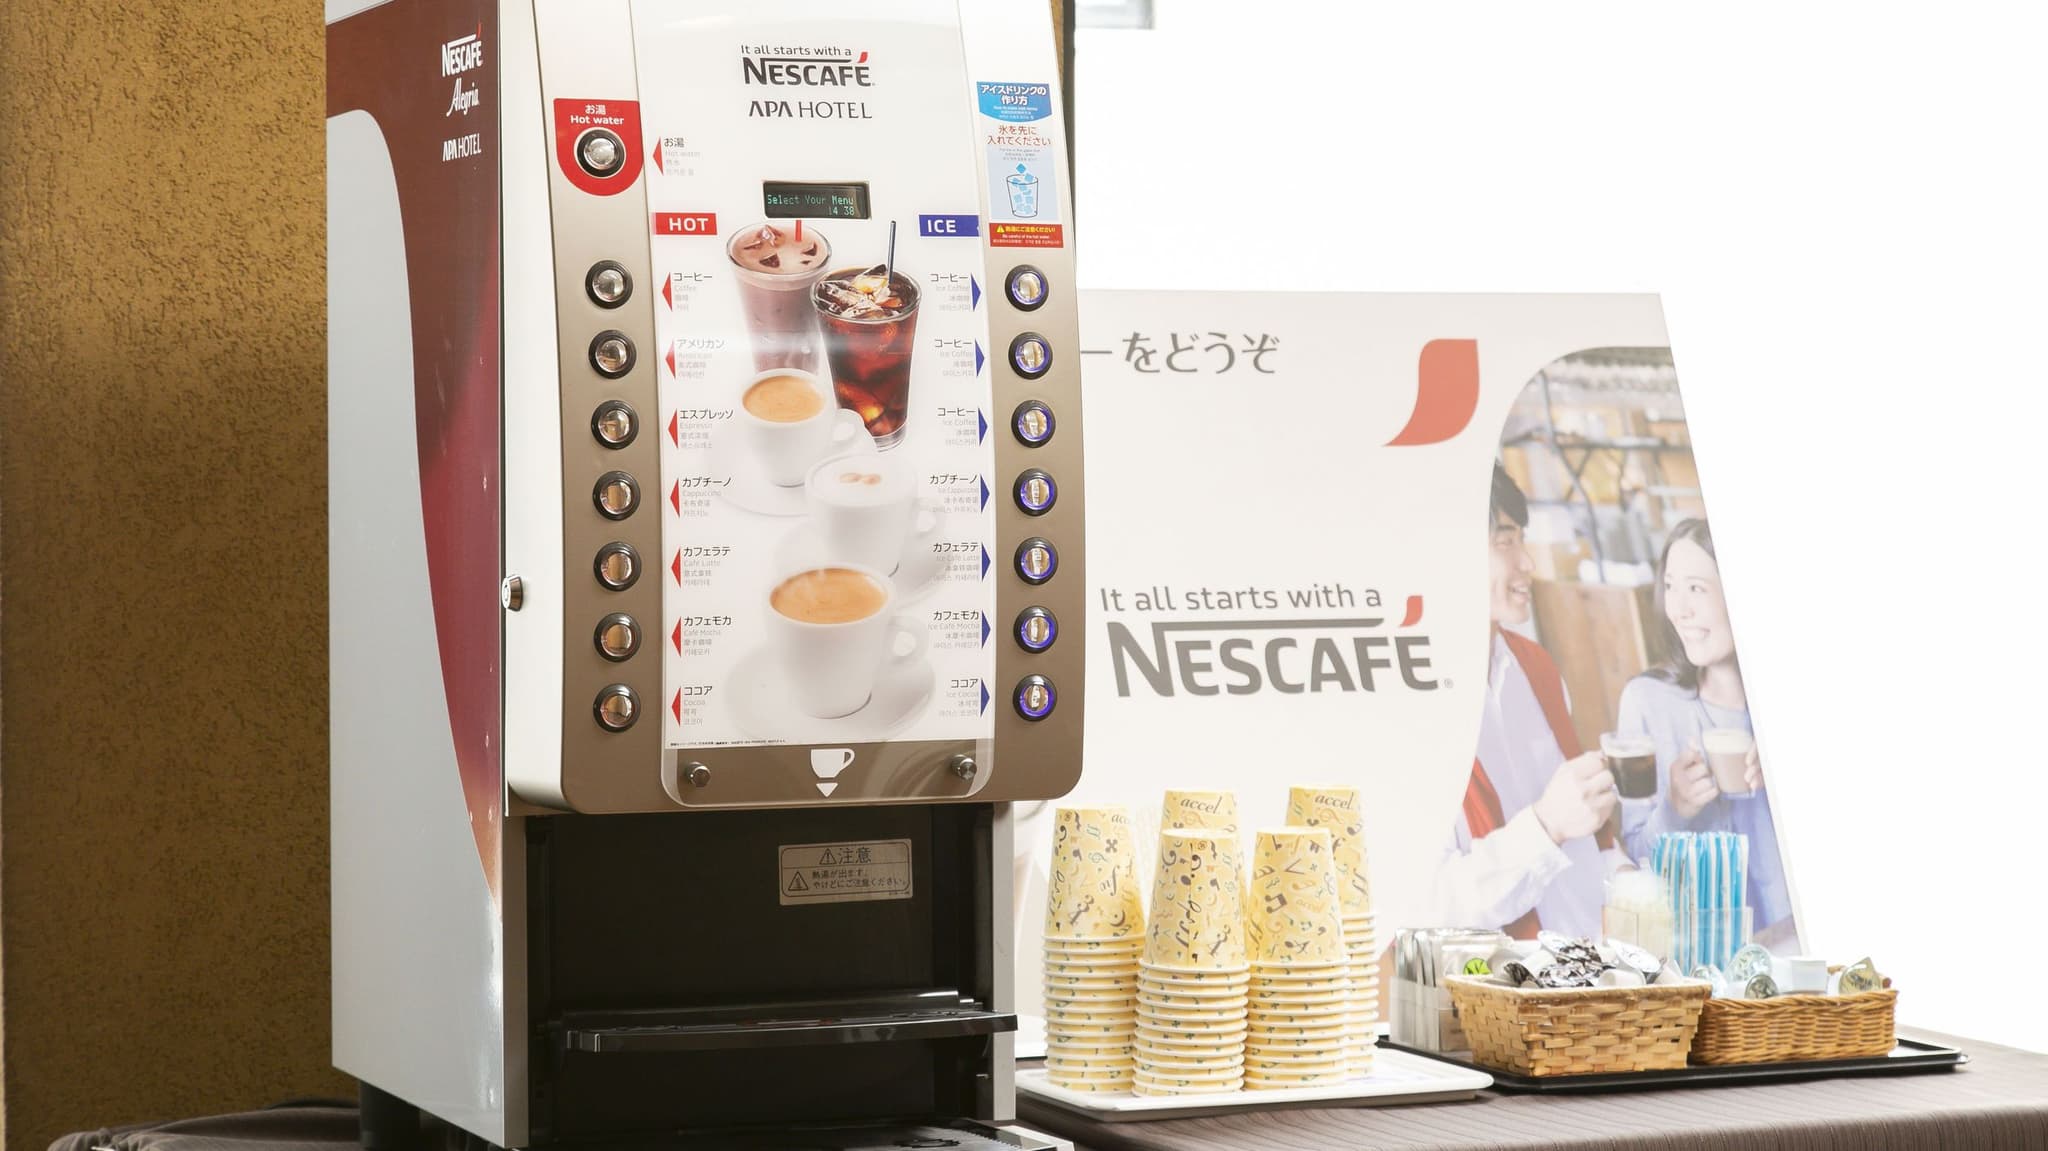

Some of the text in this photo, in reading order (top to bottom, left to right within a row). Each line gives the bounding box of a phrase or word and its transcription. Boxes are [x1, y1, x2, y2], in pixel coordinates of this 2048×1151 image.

[741, 45, 750, 54] It
[754, 45, 770, 54] all
[774, 46, 810, 56] starts
[814, 46, 841, 56] with
[981, 84, 1046, 96] アイスドリンクの
[446, 78, 480, 117] Alegria
[1001, 95, 1028, 106] 作り方
[585, 104, 606, 115] お湯
[749, 101, 872, 119] APA HOTEL
[570, 115, 624, 125] Hot water
[998, 124, 1038, 136] 氷を先に
[664, 138, 684, 148] お湯
[988, 136, 1052, 146] 入れてください
[443, 133, 482, 162] APA HOTEL
[768, 194, 854, 204] Select Your Menu
[669, 218, 708, 232] HOT
[928, 220, 956, 233] ICE
[673, 272, 712, 282] コーヒー
[930, 274, 968, 282] コーヒー
[676, 338, 726, 350] アメリカン
[934, 339, 972, 348] コーヒー
[680, 409, 734, 420] エスプレッソ
[937, 408, 976, 416] コーヒー
[682, 477, 732, 488] カプチーノ
[930, 474, 978, 484] カプチーノ
[684, 546, 732, 557] カフェラテ
[933, 542, 979, 552] カフェラテ
[1100, 584, 1382, 612] It all starts with a
[934, 610, 980, 620] カフェモカ
[684, 616, 732, 626] カフェモカ
[951, 678, 978, 688] ココア
[684, 686, 713, 696] ココア
[1180, 795, 1222, 814] accel
[1314, 792, 1354, 810] accel
[838, 847, 872, 864] 注意
